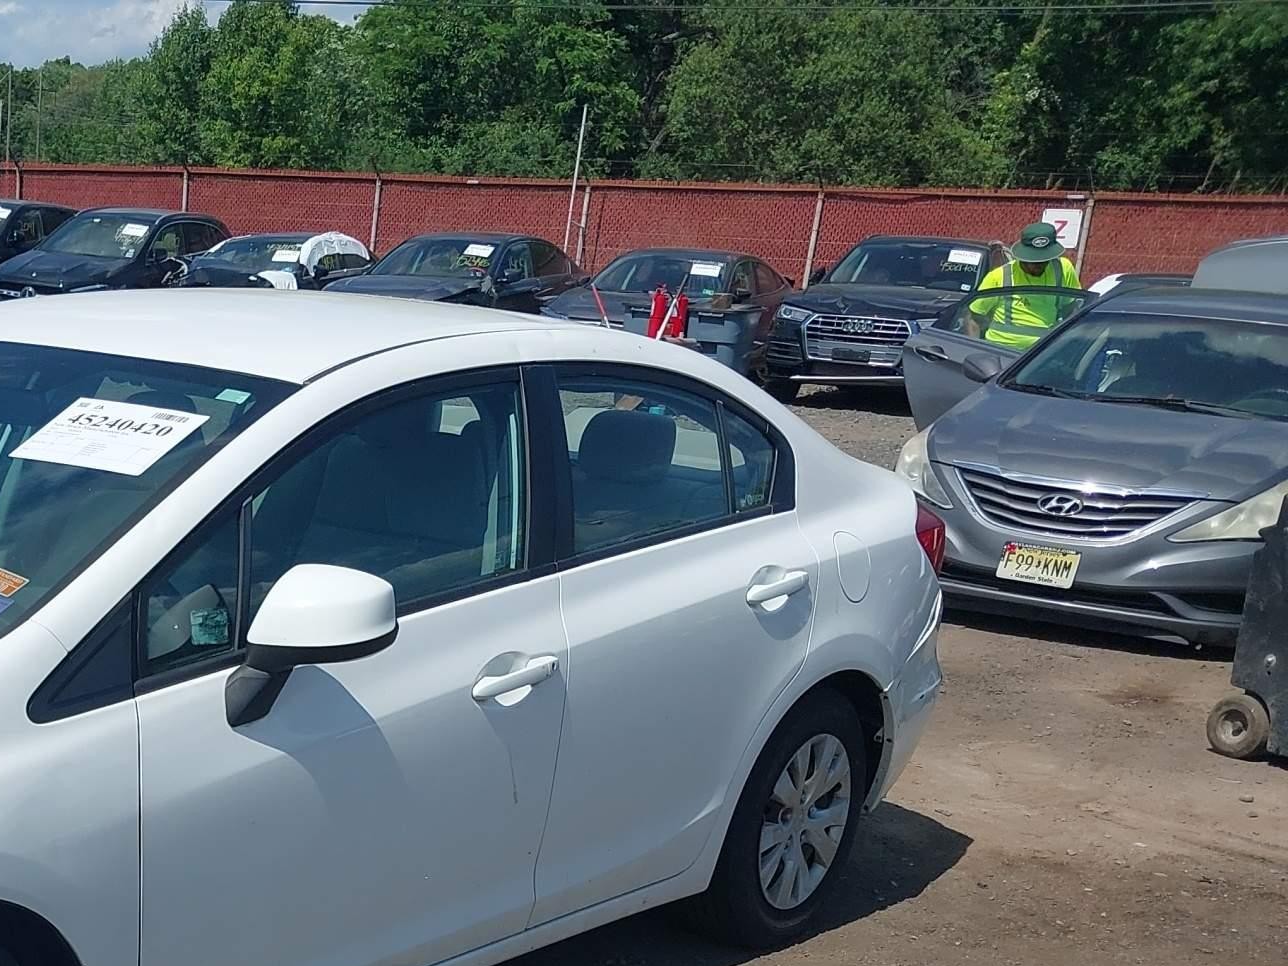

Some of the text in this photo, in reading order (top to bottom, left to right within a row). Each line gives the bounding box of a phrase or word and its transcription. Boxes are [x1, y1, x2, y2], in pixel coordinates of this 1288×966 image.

[68, 413, 173, 437] 45240420
[1004, 552, 1072, 579] F99 KNM
